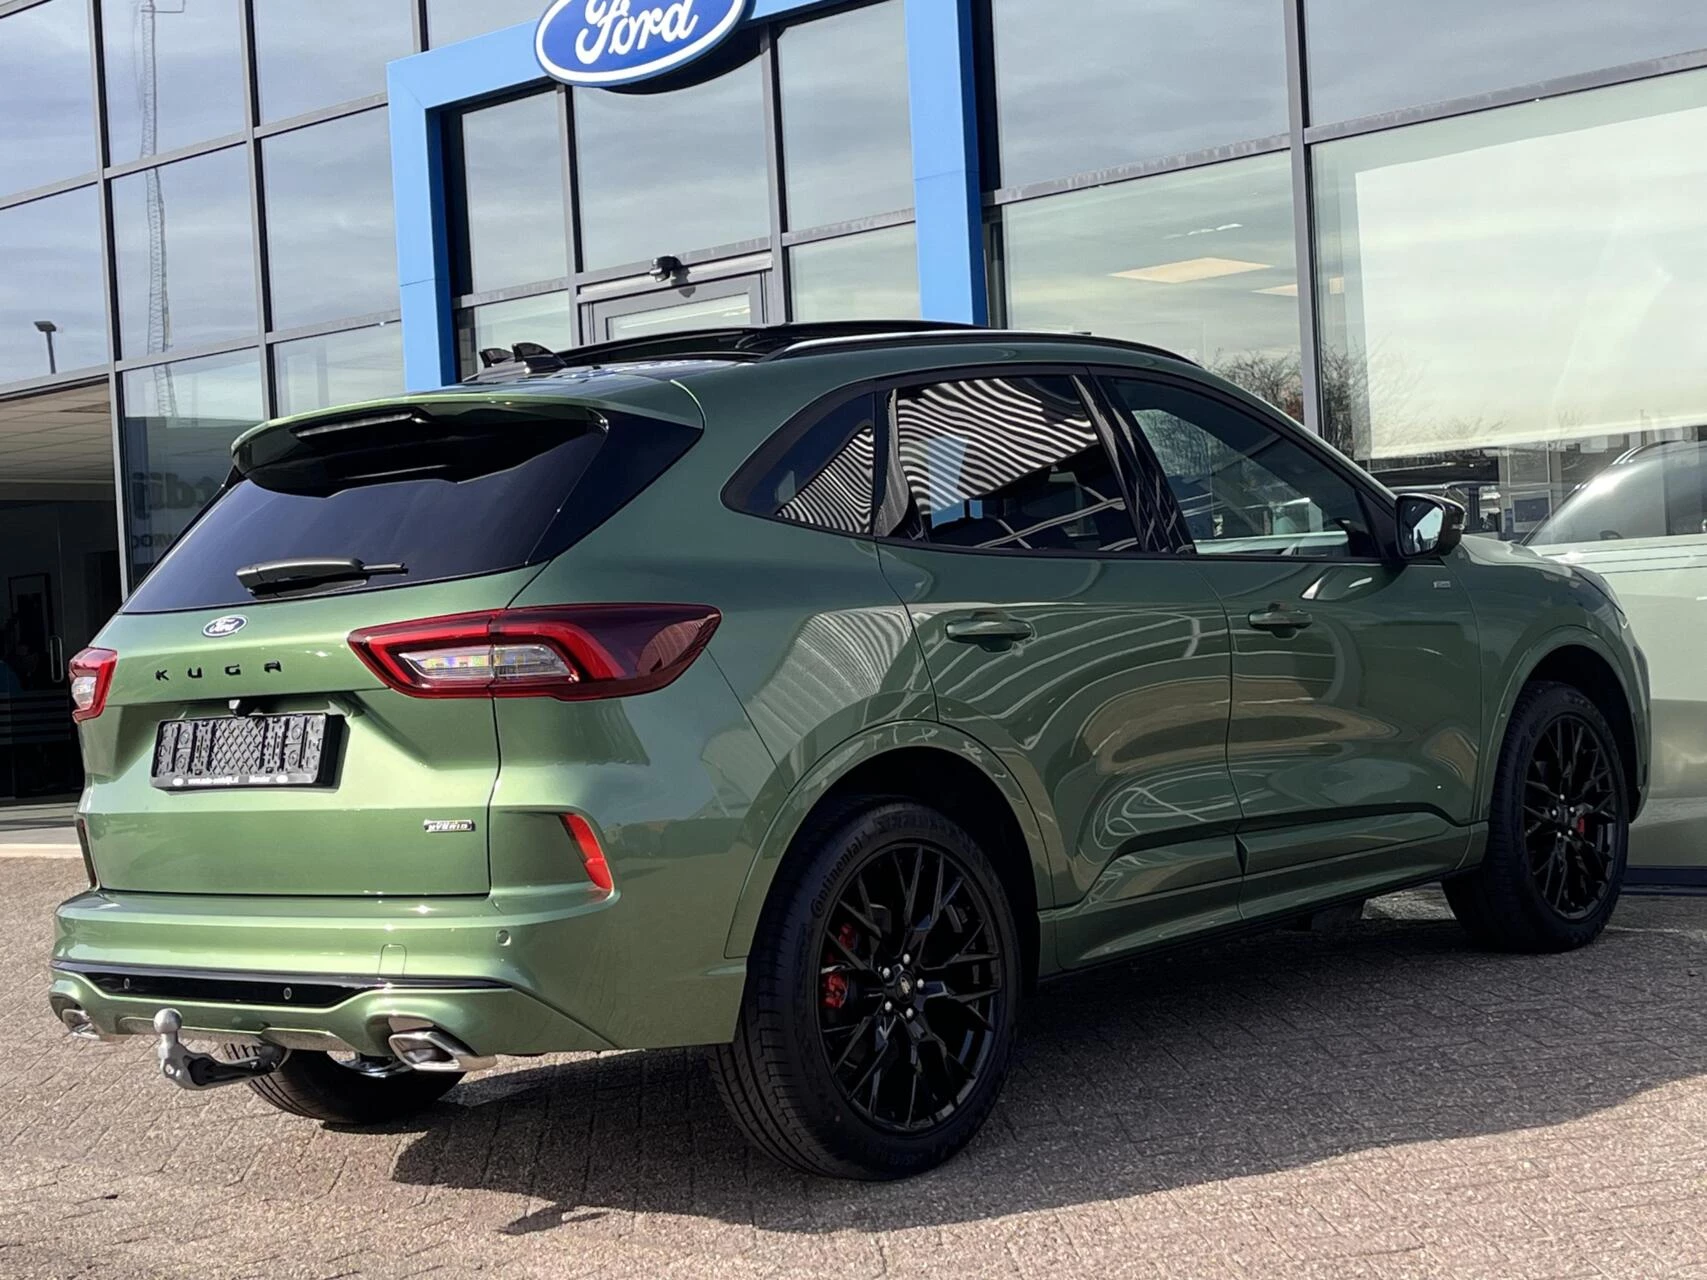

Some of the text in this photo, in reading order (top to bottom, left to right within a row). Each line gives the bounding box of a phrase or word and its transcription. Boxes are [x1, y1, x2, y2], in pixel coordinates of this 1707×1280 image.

[574, 0, 699, 64] Ford
[155, 659, 283, 682] KUGA
[810, 836, 864, 919] Continental
